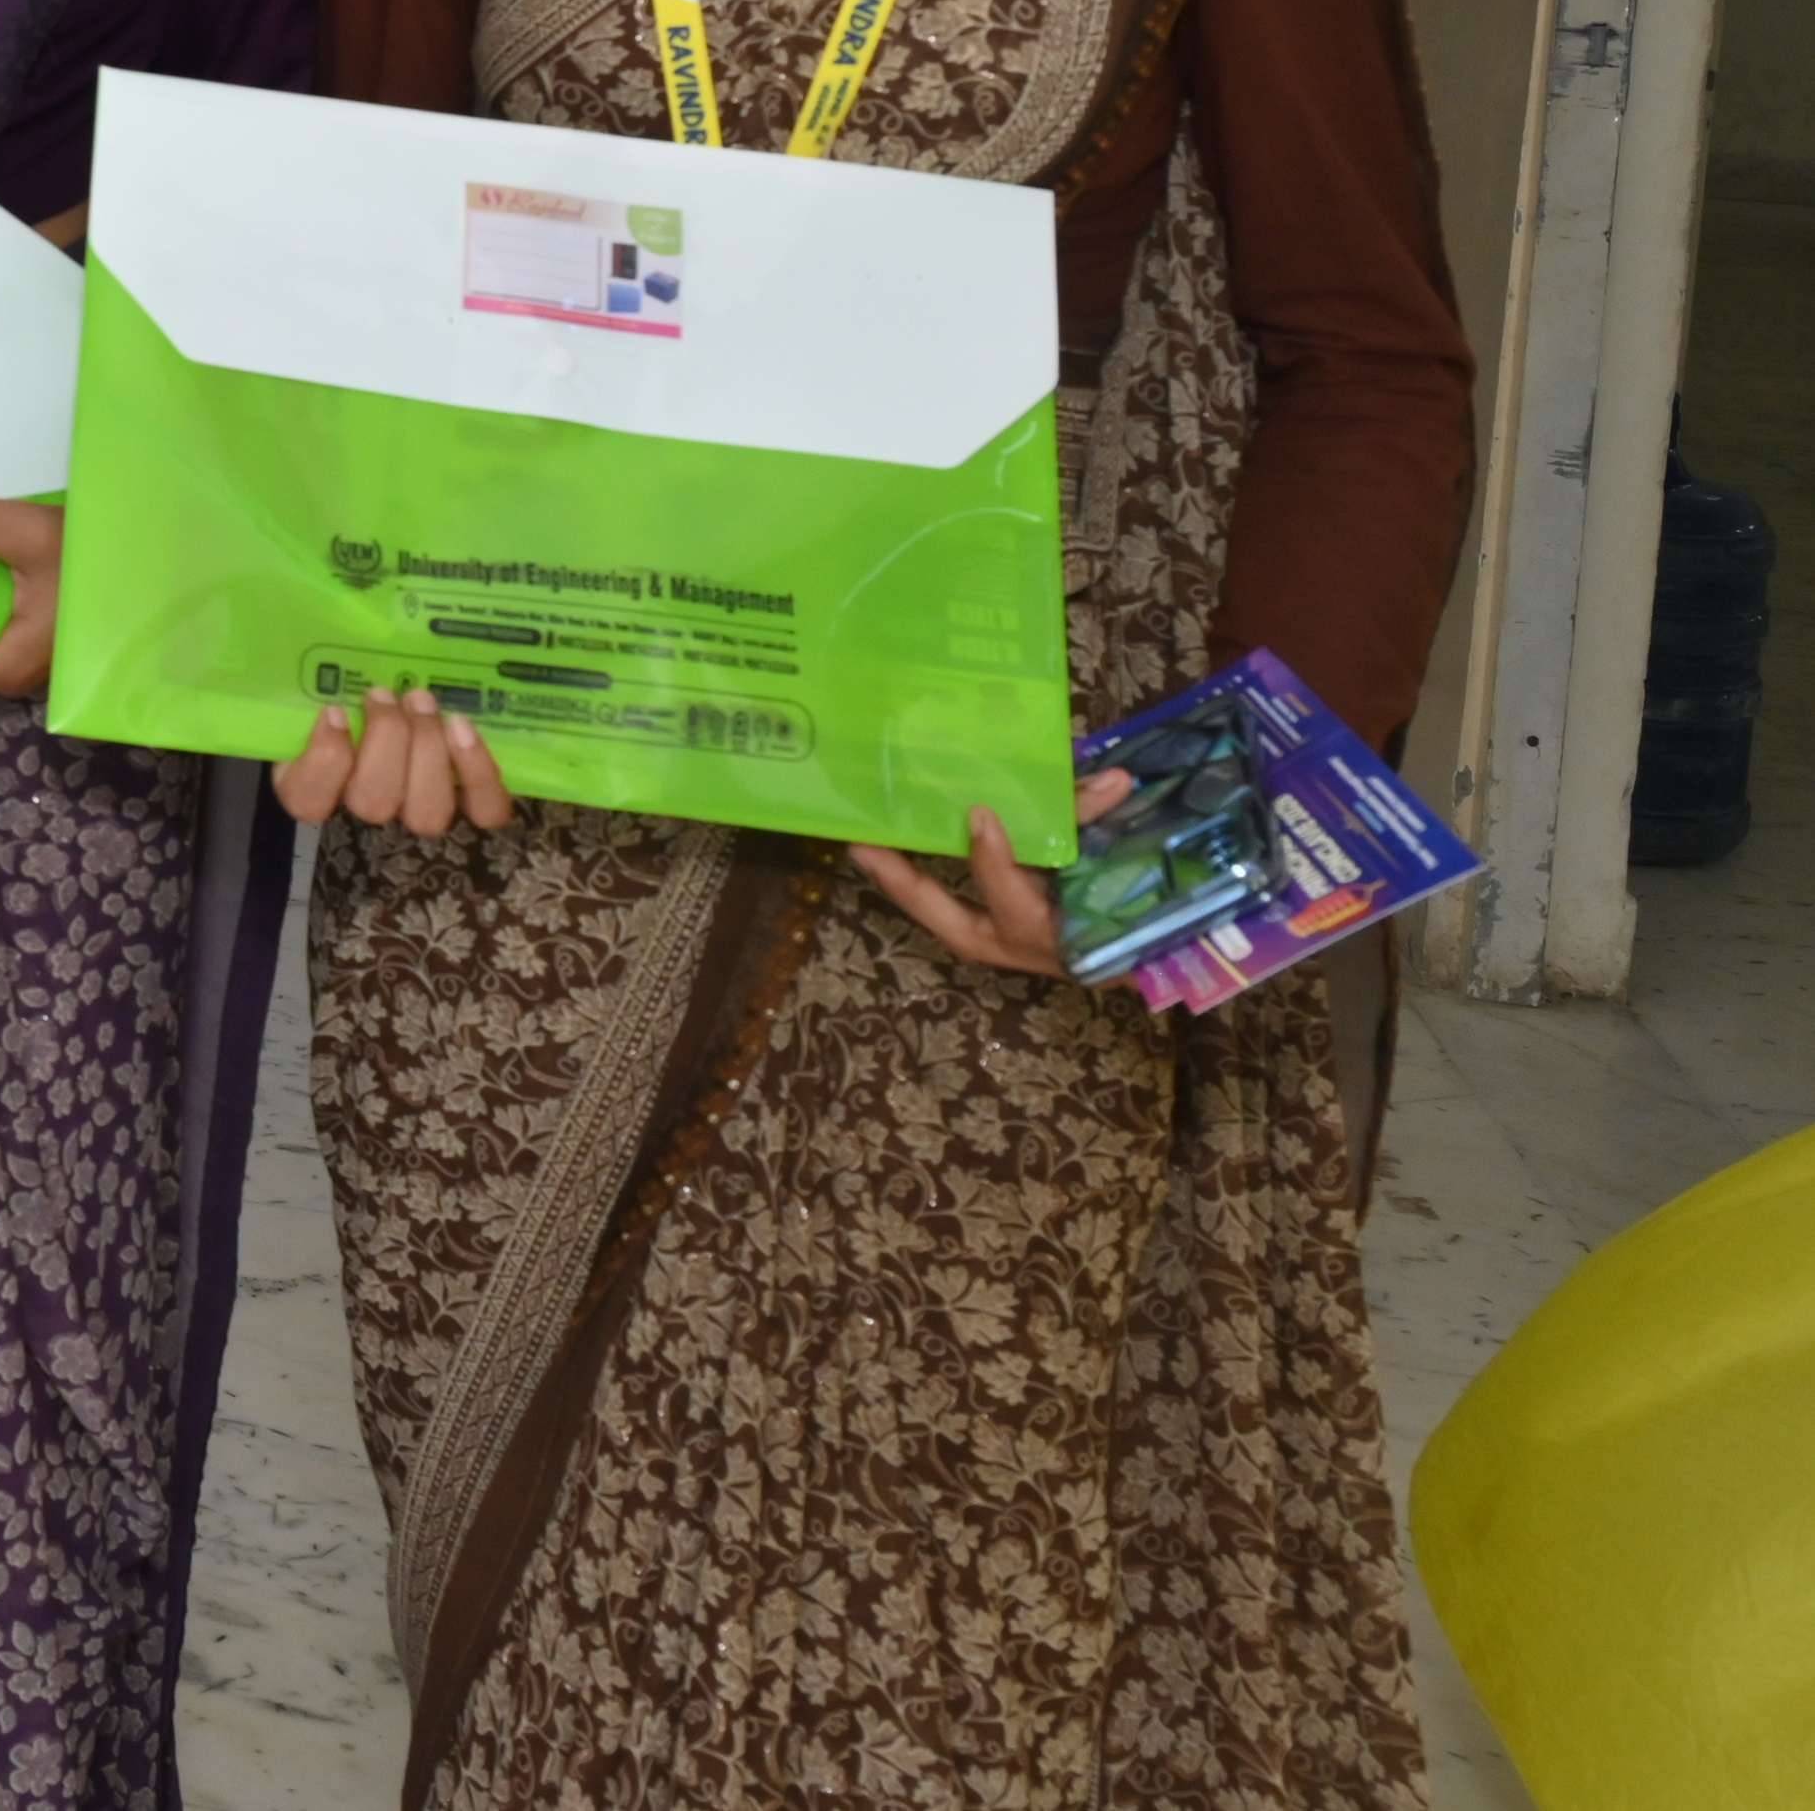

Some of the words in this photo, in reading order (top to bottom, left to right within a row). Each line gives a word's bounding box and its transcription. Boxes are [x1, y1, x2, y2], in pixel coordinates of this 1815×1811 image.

[666, 25, 709, 146] RAVINDR
[526, 563, 643, 601] Engineering
[648, 575, 663, 598] &
[670, 576, 796, 617] Management
